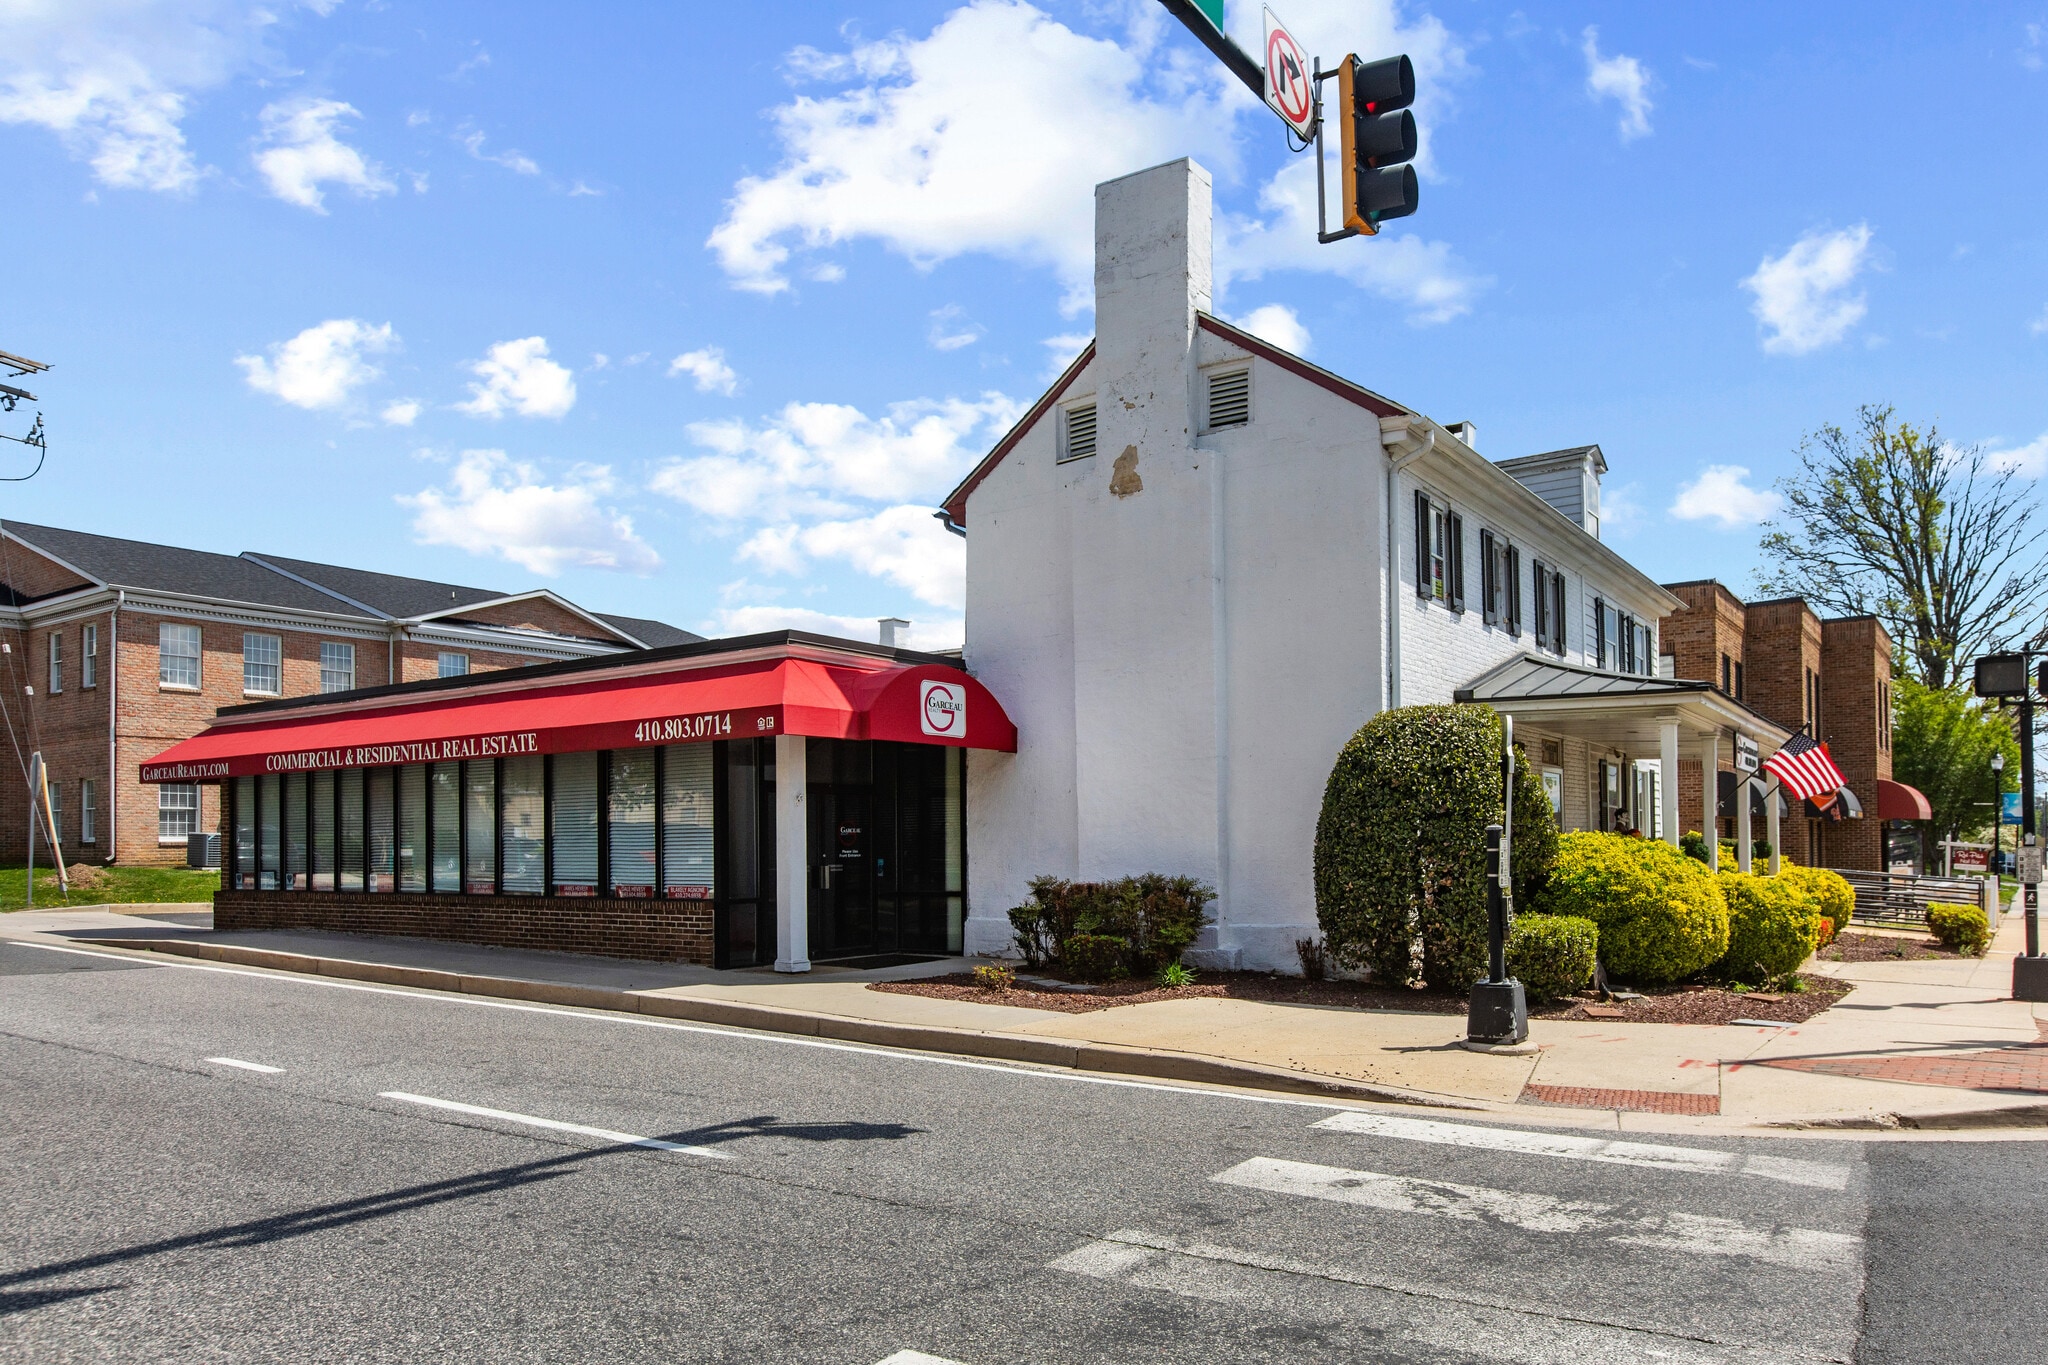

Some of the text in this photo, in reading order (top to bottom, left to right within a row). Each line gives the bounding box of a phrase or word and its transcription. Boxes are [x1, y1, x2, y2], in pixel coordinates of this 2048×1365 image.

[928, 696, 963, 711] GARCEAU
[634, 713, 732, 742] 410.803.0714
[266, 733, 538, 771] COMMERCIAL & RESIDENTIAL REAL ESTATE
